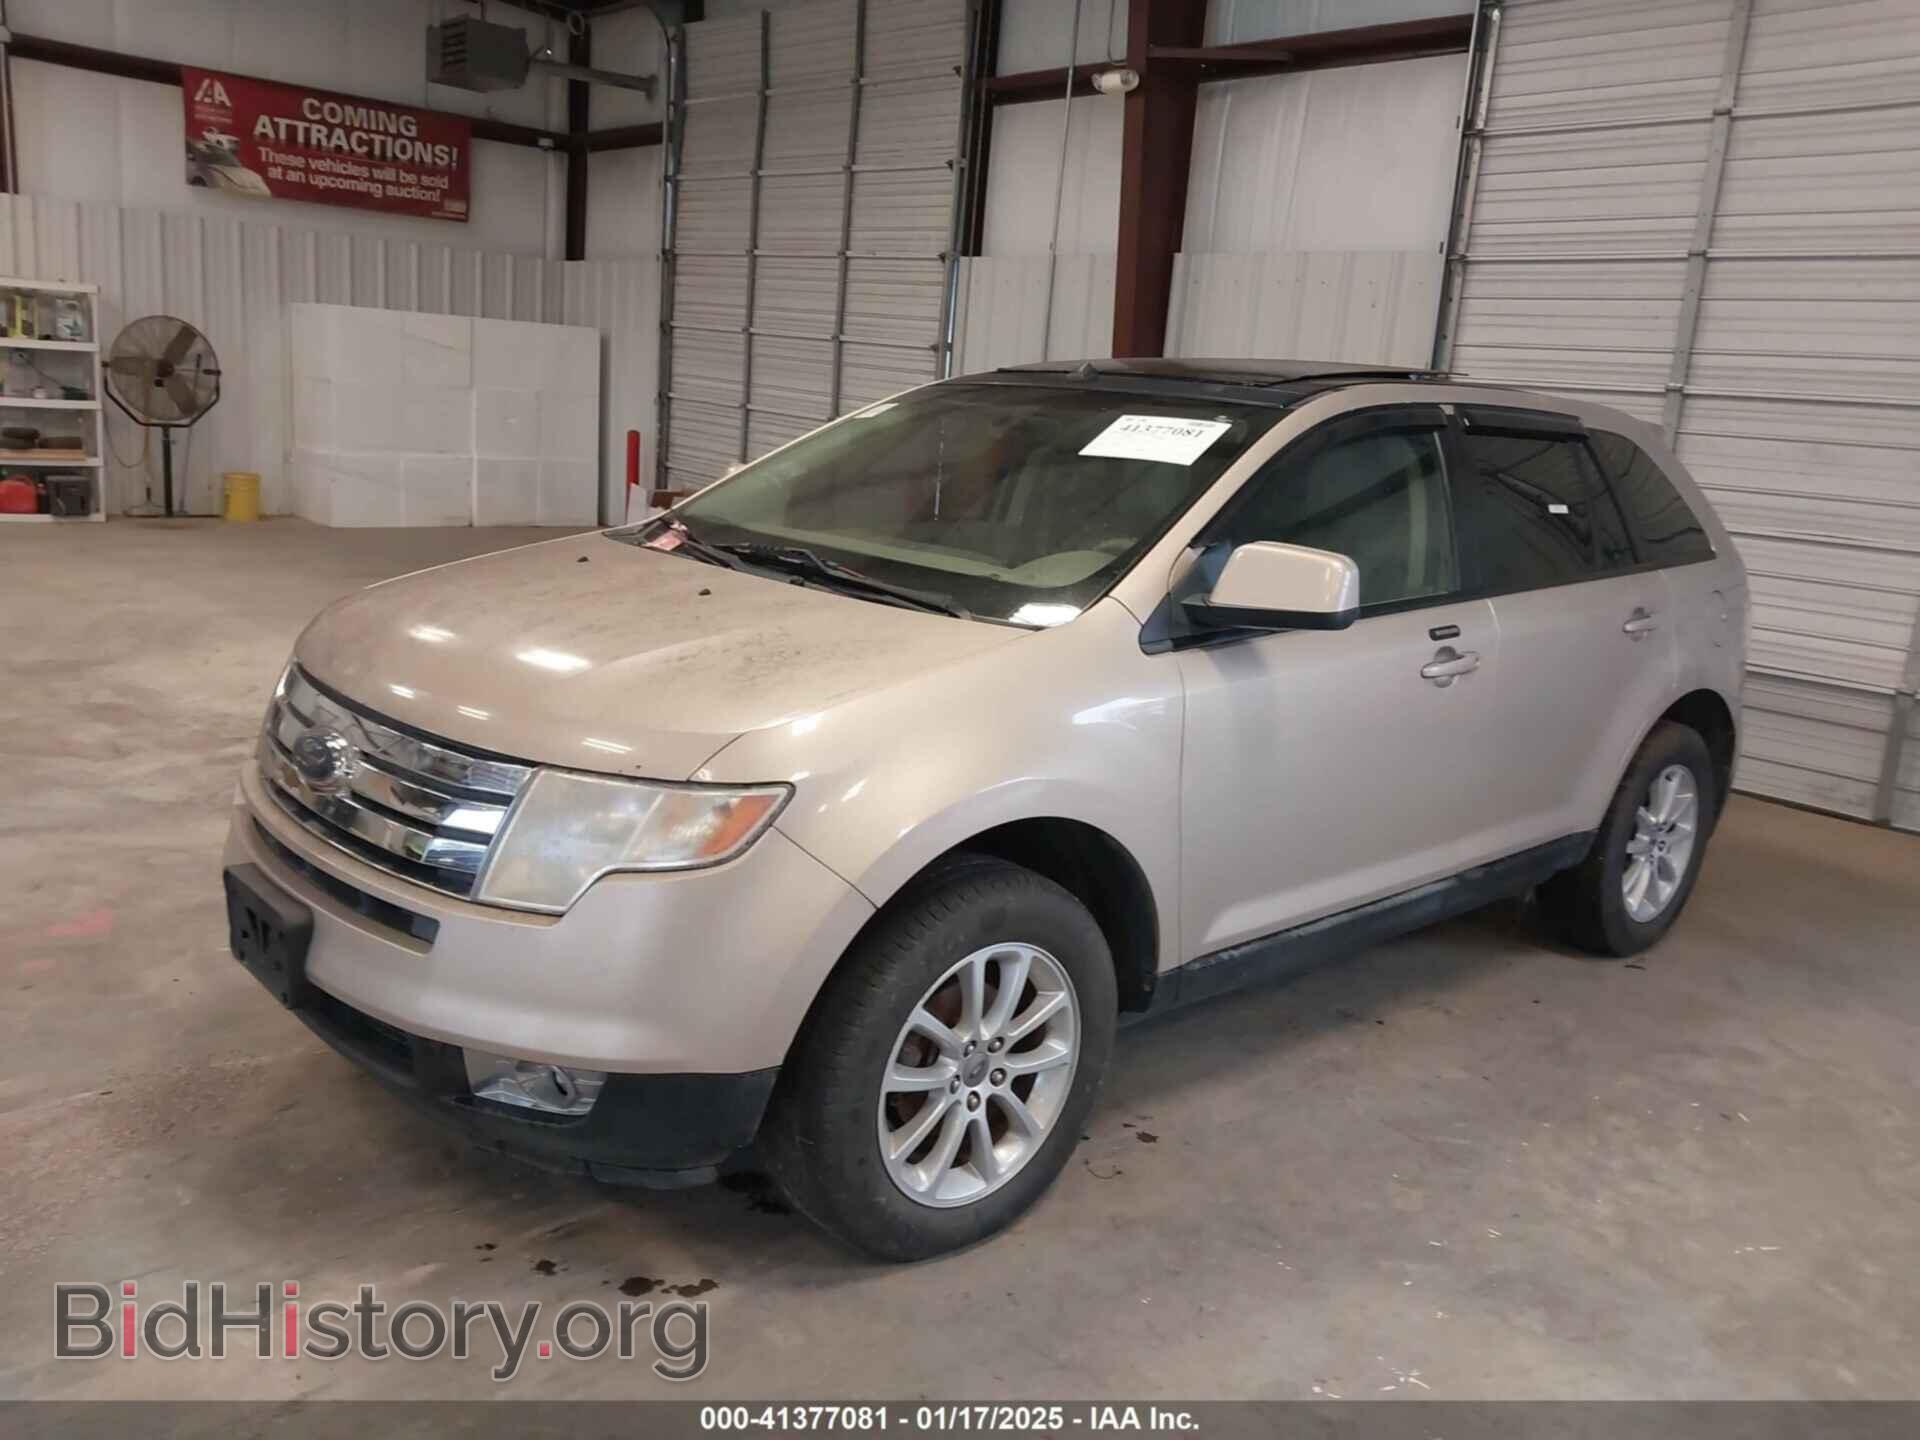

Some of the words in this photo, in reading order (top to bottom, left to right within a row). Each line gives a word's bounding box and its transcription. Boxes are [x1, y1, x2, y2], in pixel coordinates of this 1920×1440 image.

[302, 97, 418, 138] COMING
[253, 114, 459, 169] ATTRACTIONS!
[257, 146, 306, 169] These
[307, 157, 370, 179] vehicles
[371, 167, 397, 182] will
[399, 169, 418, 185] be
[419, 174, 449, 190] sold
[267, 165, 283, 180] at
[285, 169, 306, 184] an
[308, 173, 384, 199] upcoming
[385, 184, 441, 203] auction!
